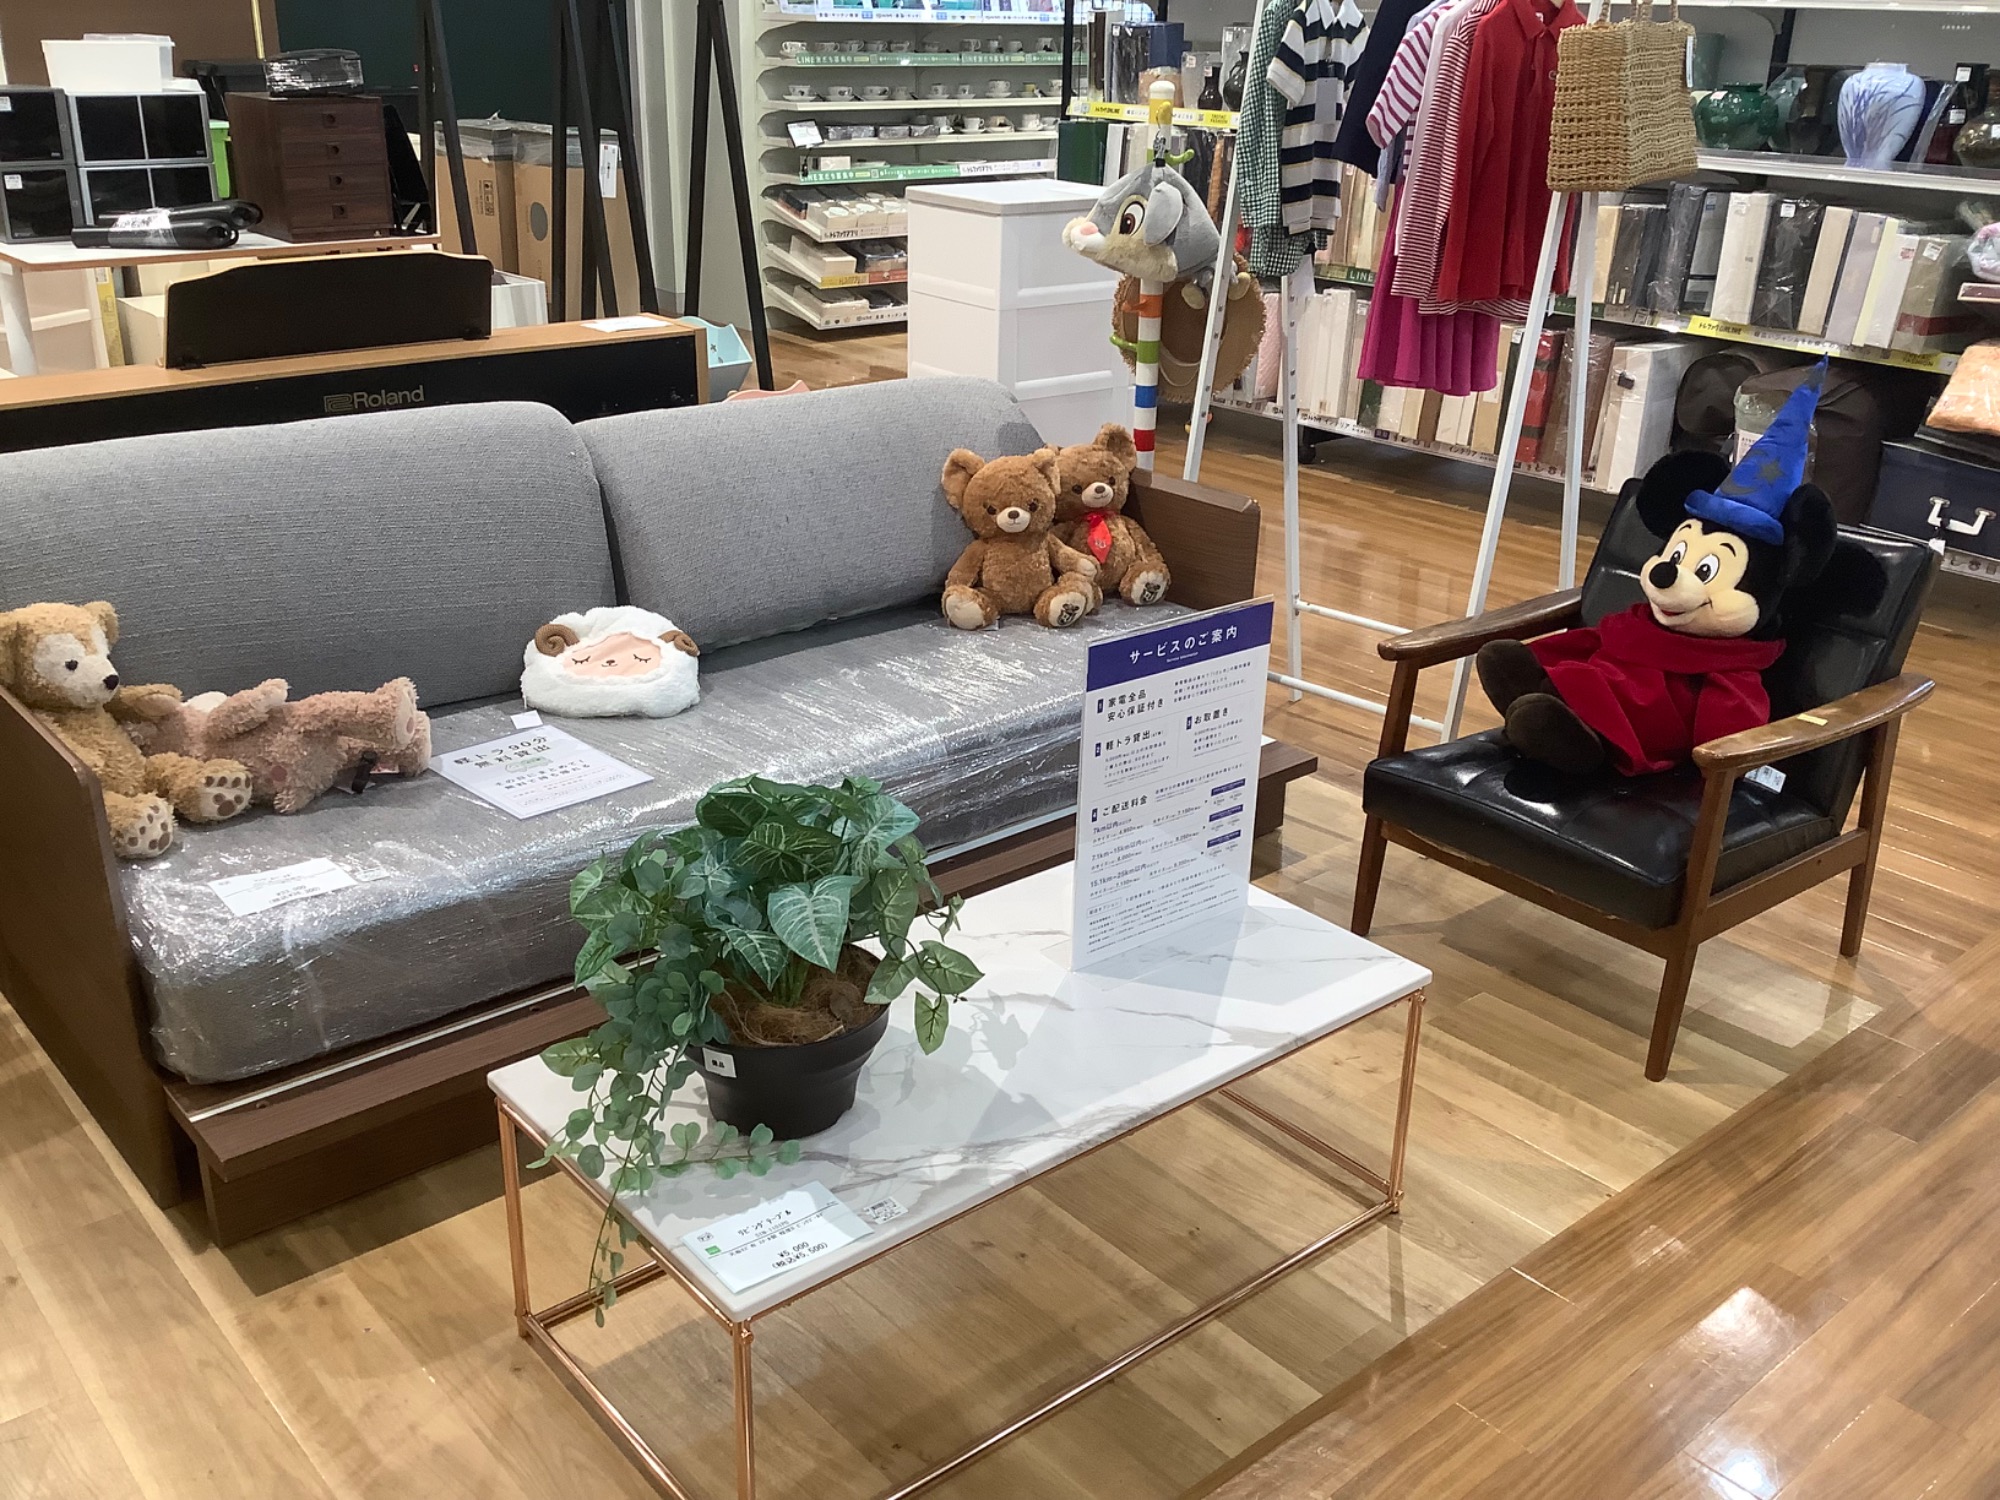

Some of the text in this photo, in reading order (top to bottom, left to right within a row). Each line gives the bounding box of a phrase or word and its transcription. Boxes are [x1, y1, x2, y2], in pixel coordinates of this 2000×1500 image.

[354, 385, 424, 409] Roland
[1130, 625, 1238, 664] サービスのご案内
[1107, 697, 1165, 722] 安心保証付き
[1108, 689, 1147, 708] 家電全品
[1194, 707, 1229, 725] お取置き
[453, 735, 549, 766] 軽トラ90分
[1105, 729, 1150, 751] 軽トラ貸出
[476, 745, 552, 769] 無料貸出
[1102, 794, 1148, 817] ご配送料金
[777, 1241, 810, 1259] ¥5,000
